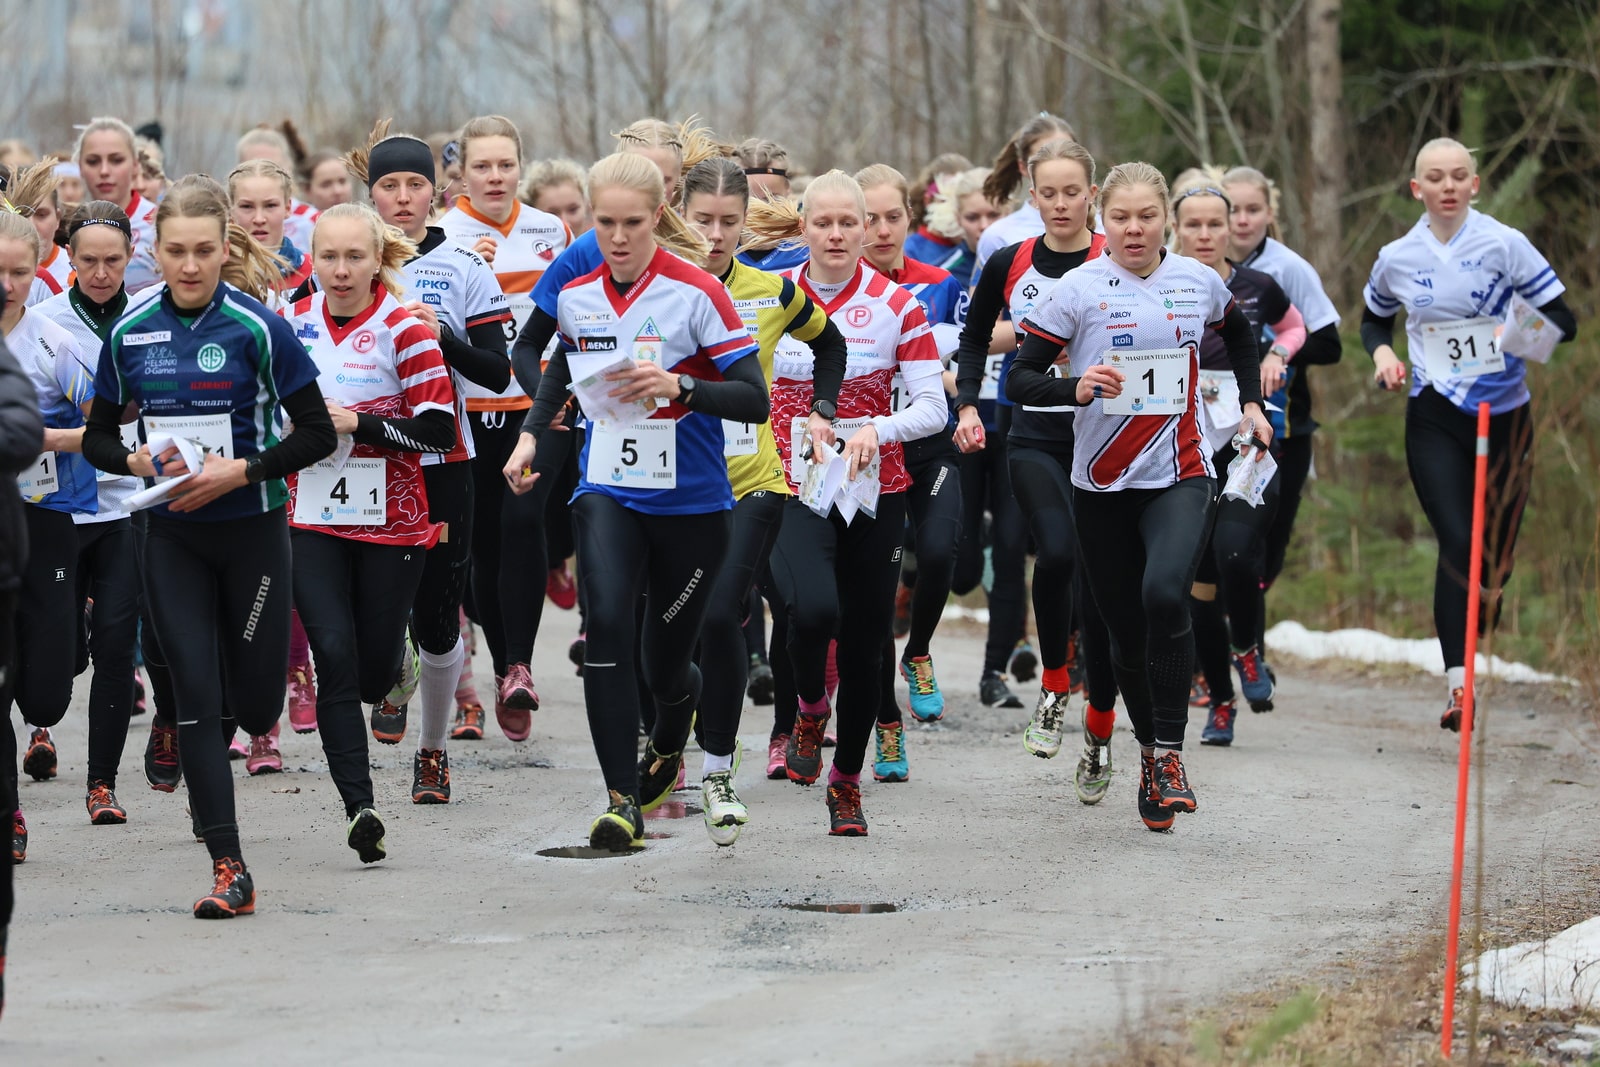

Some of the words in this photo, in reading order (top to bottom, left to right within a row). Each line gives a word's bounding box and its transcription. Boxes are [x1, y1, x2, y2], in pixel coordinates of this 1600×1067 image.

[625, 270, 651, 300] noname
[75, 303, 99, 329] noname
[1106, 322, 1138, 330] motonet
[1110, 311, 1131, 319] ABLOY
[1447, 335, 1476, 360] 31
[1488, 340, 1496, 354] 1
[144, 359, 178, 367] HELSINKI
[144, 367, 176, 375] O-Games
[343, 362, 376, 370] noname
[1142, 368, 1154, 395] 1
[1177, 377, 1184, 394] 1
[191, 399, 232, 407] noname
[621, 438, 638, 466] 5
[658, 450, 667, 467] 1
[40, 458, 49, 474] 1
[330, 477, 349, 505] 4
[369, 488, 378, 505] 1
[930, 466, 949, 496] noname
[243, 575, 271, 642] noname
[662, 568, 703, 624] noname
